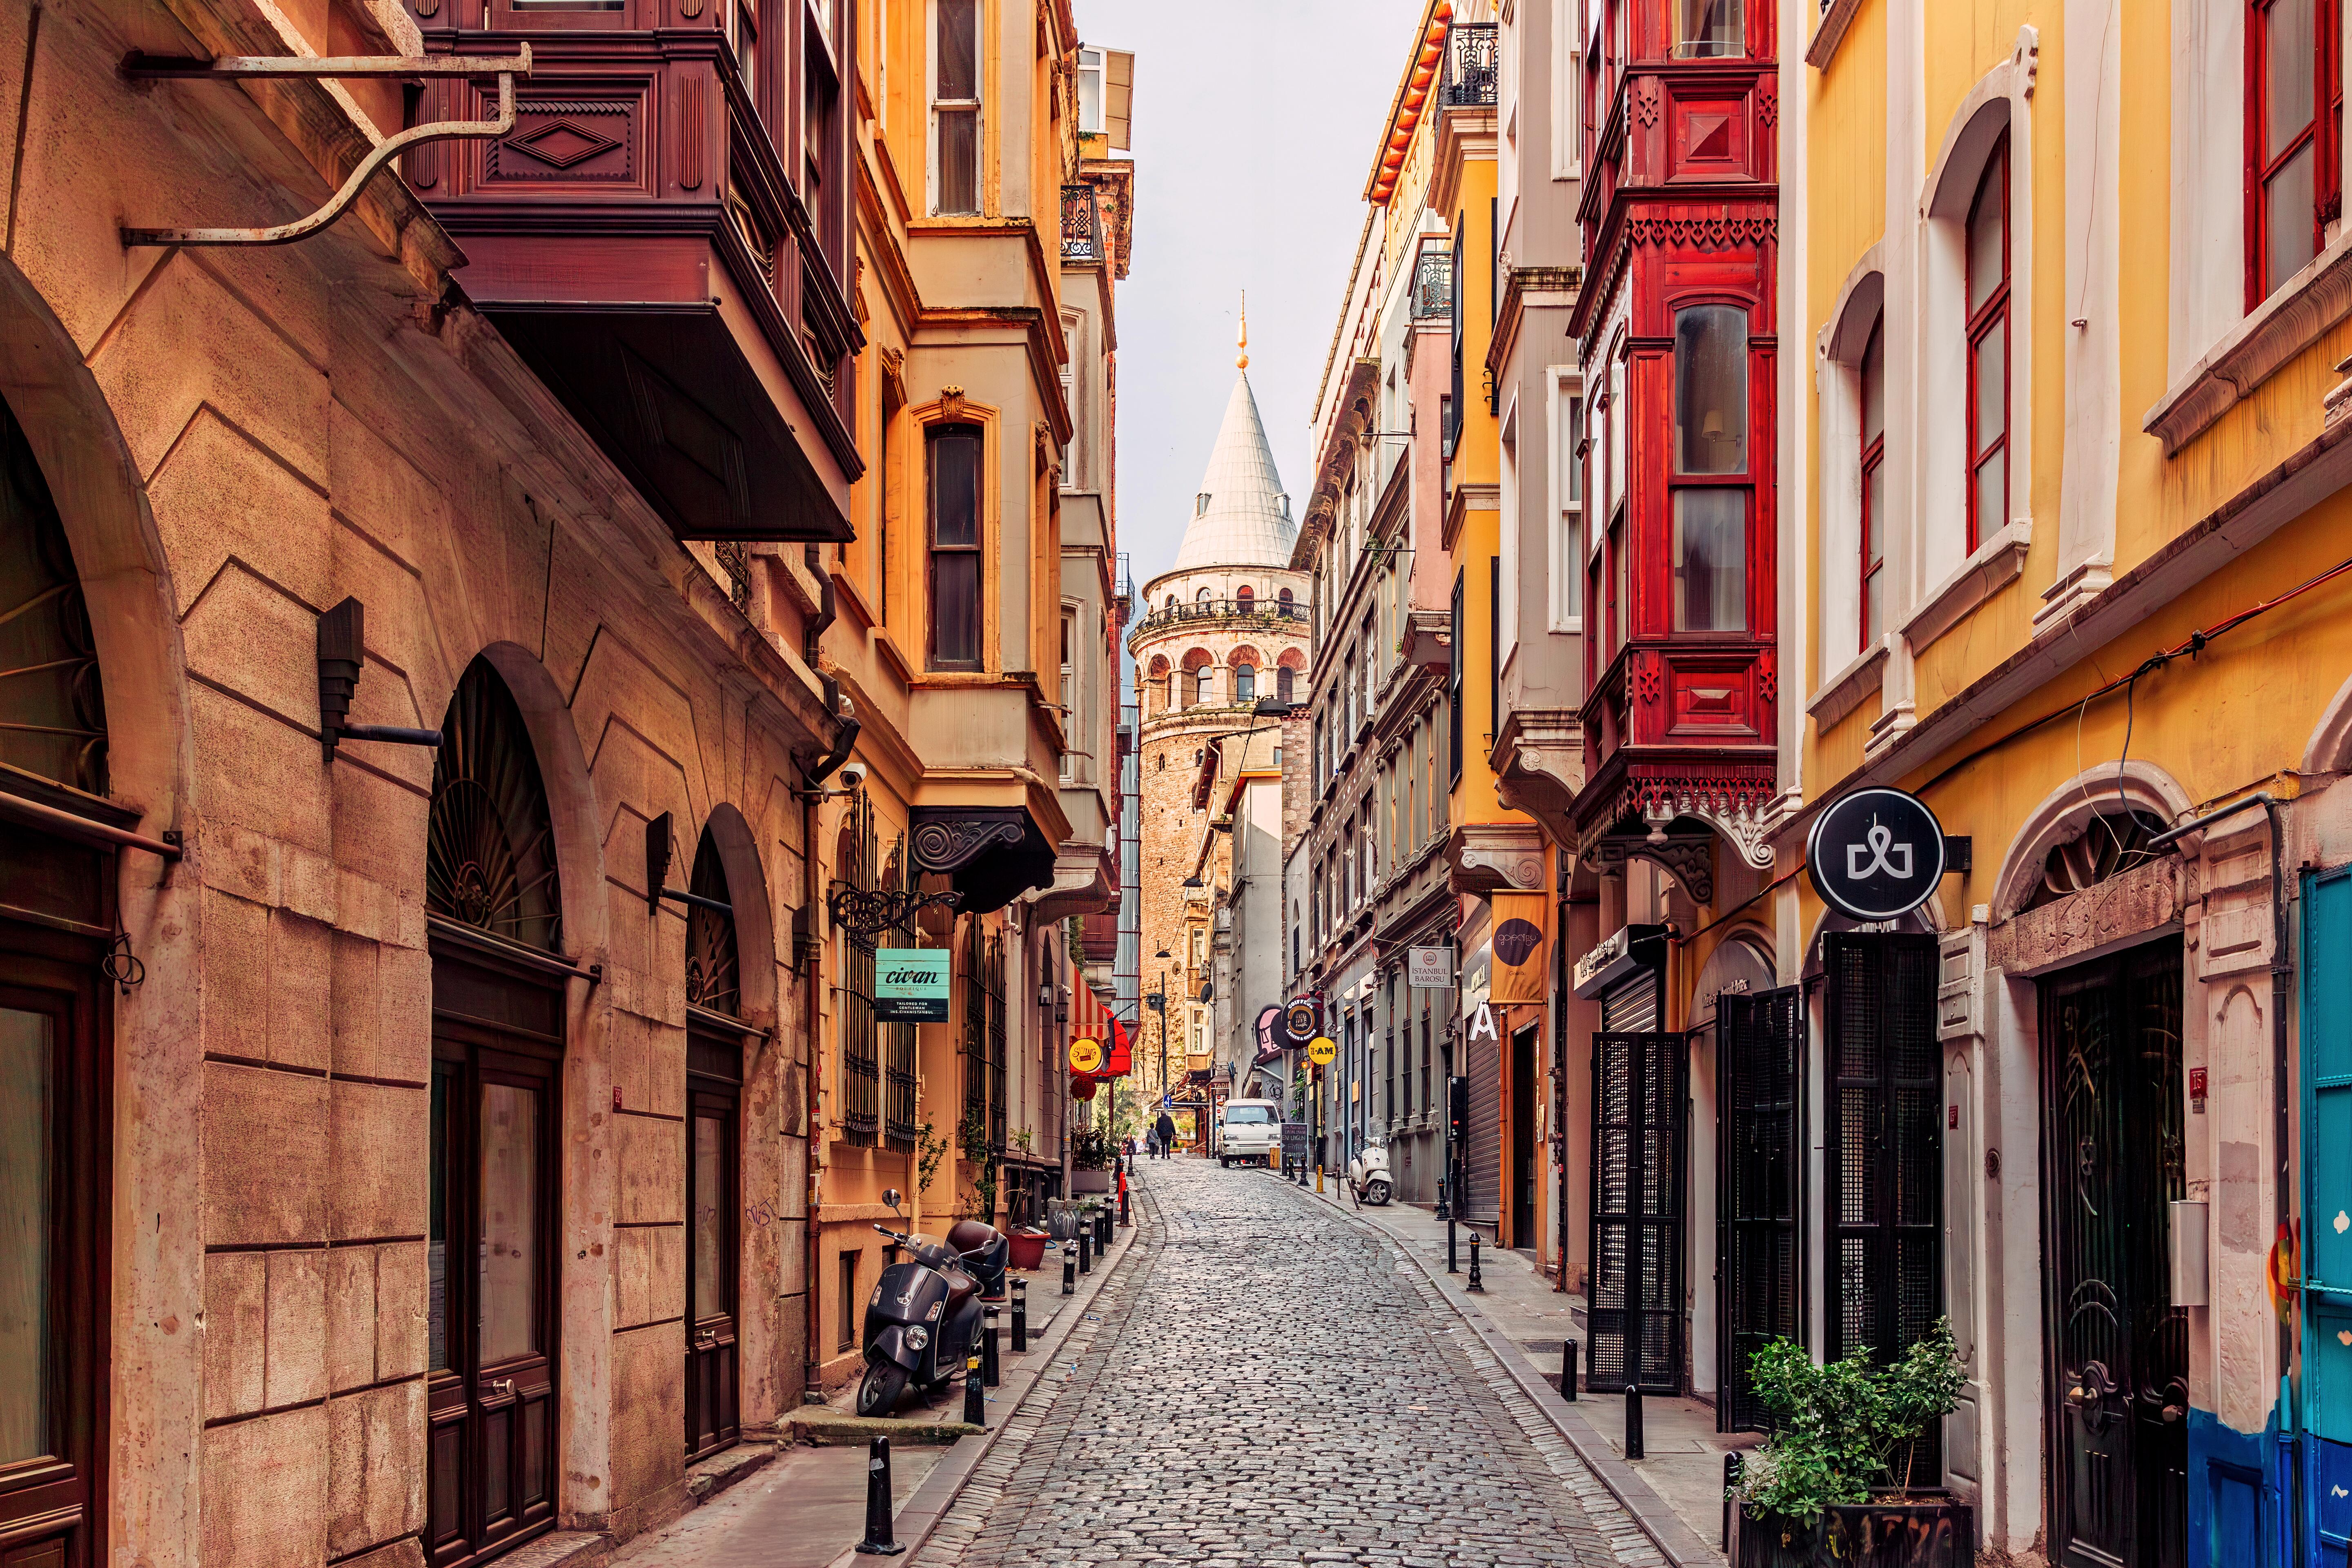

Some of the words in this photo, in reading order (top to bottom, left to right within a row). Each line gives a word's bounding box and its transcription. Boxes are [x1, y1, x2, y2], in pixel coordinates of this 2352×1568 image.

[886, 967, 939, 984] civan
[1412, 966, 1448, 974] İSTANBUL
[1469, 1000, 1498, 1041] A
[1286, 1029, 1300, 1040] LADIES
[1303, 1029, 1317, 1040] GENTS
[2193, 1074, 2202, 1089] 15
